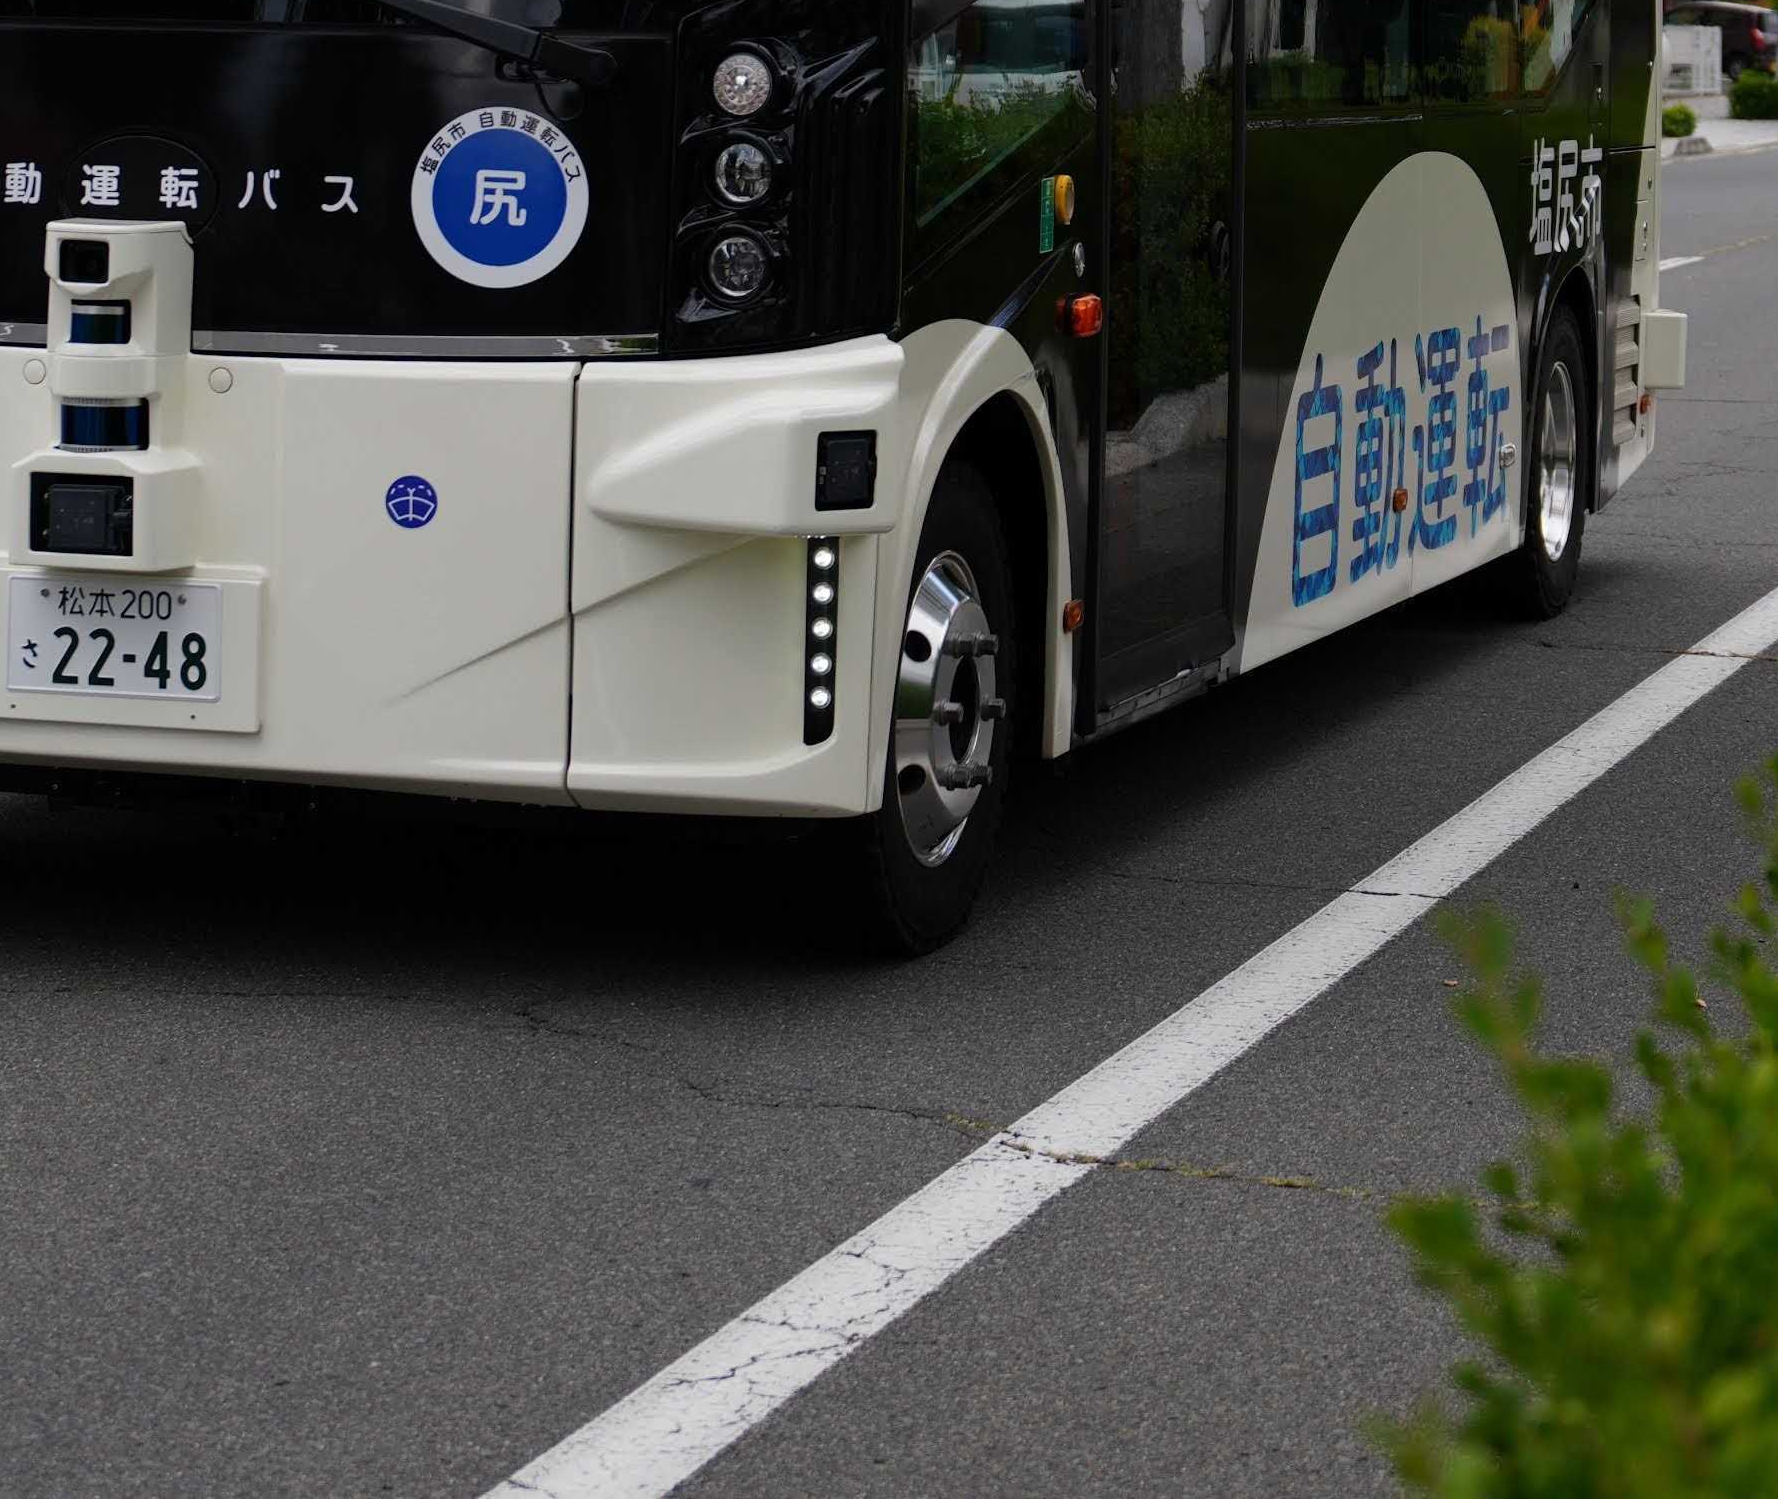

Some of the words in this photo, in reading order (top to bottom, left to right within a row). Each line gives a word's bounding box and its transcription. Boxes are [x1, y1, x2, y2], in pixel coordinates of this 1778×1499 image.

[419, 122, 467, 176] 塩尻市
[478, 110, 581, 183] 自動運転バス
[469, 169, 527, 227] 尻
[1528, 133, 1603, 256] 塩尻市
[1292, 314, 1510, 608] 自動運転
[21, 638, 38, 669] さ
[52, 626, 207, 691] 22-48
